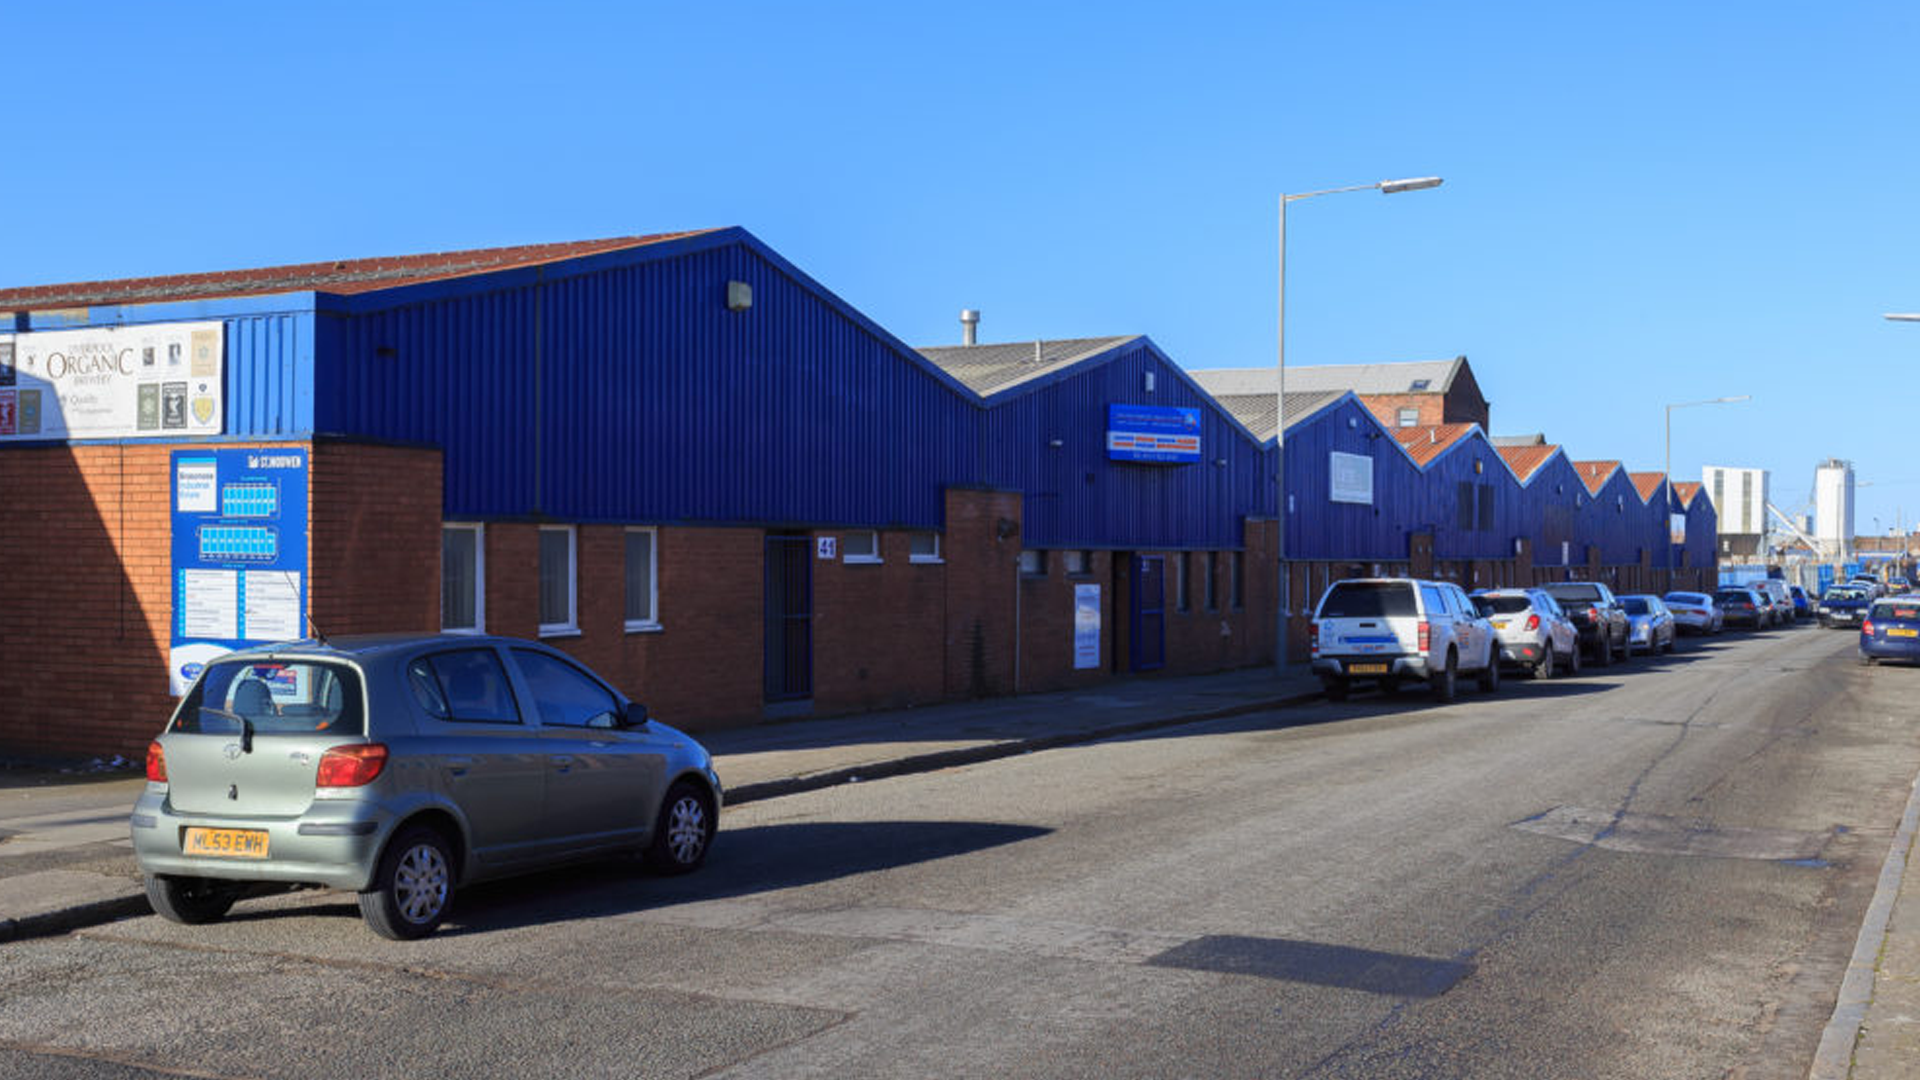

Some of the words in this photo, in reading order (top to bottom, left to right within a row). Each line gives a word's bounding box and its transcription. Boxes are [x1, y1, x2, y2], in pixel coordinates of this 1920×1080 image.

[46, 347, 134, 379] ORGANIC
[192, 831, 231, 851] ML53
[234, 834, 265, 853] EWH
